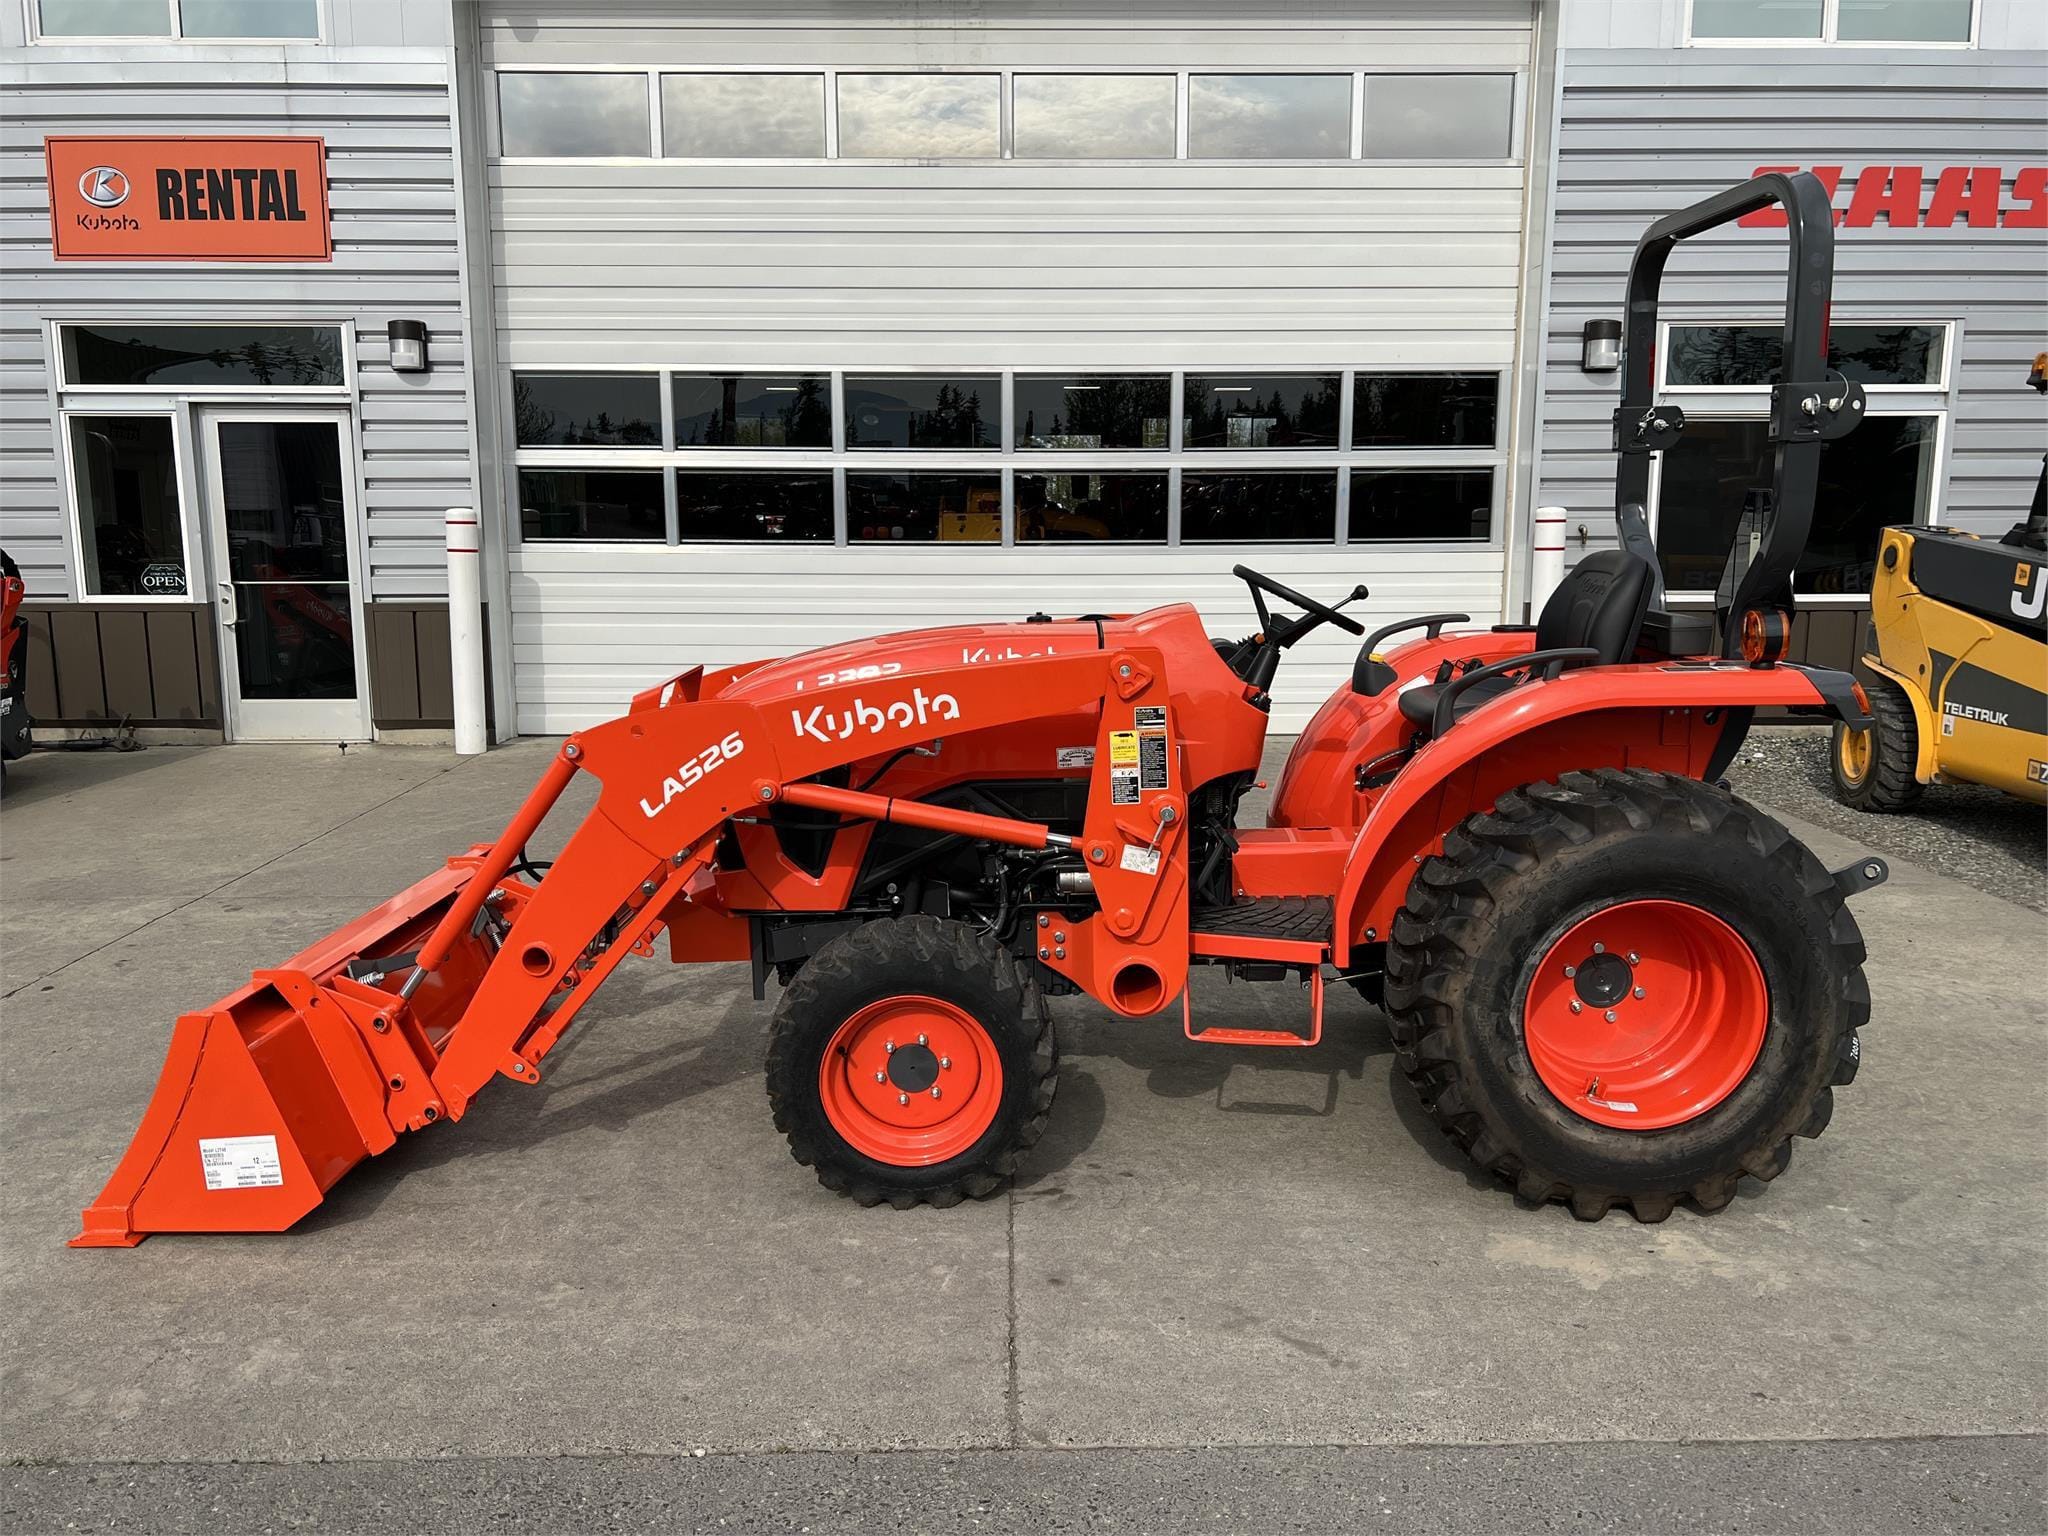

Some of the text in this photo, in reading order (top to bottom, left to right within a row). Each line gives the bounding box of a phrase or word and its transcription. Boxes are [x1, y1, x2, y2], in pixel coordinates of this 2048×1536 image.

[156, 168, 307, 221] RENTAL
[77, 213, 140, 231] Kubota
[143, 576, 186, 587] OPEN
[791, 688, 961, 743] Kubota
[1944, 701, 2009, 726] TELETRUK
[639, 730, 744, 818] LA526
